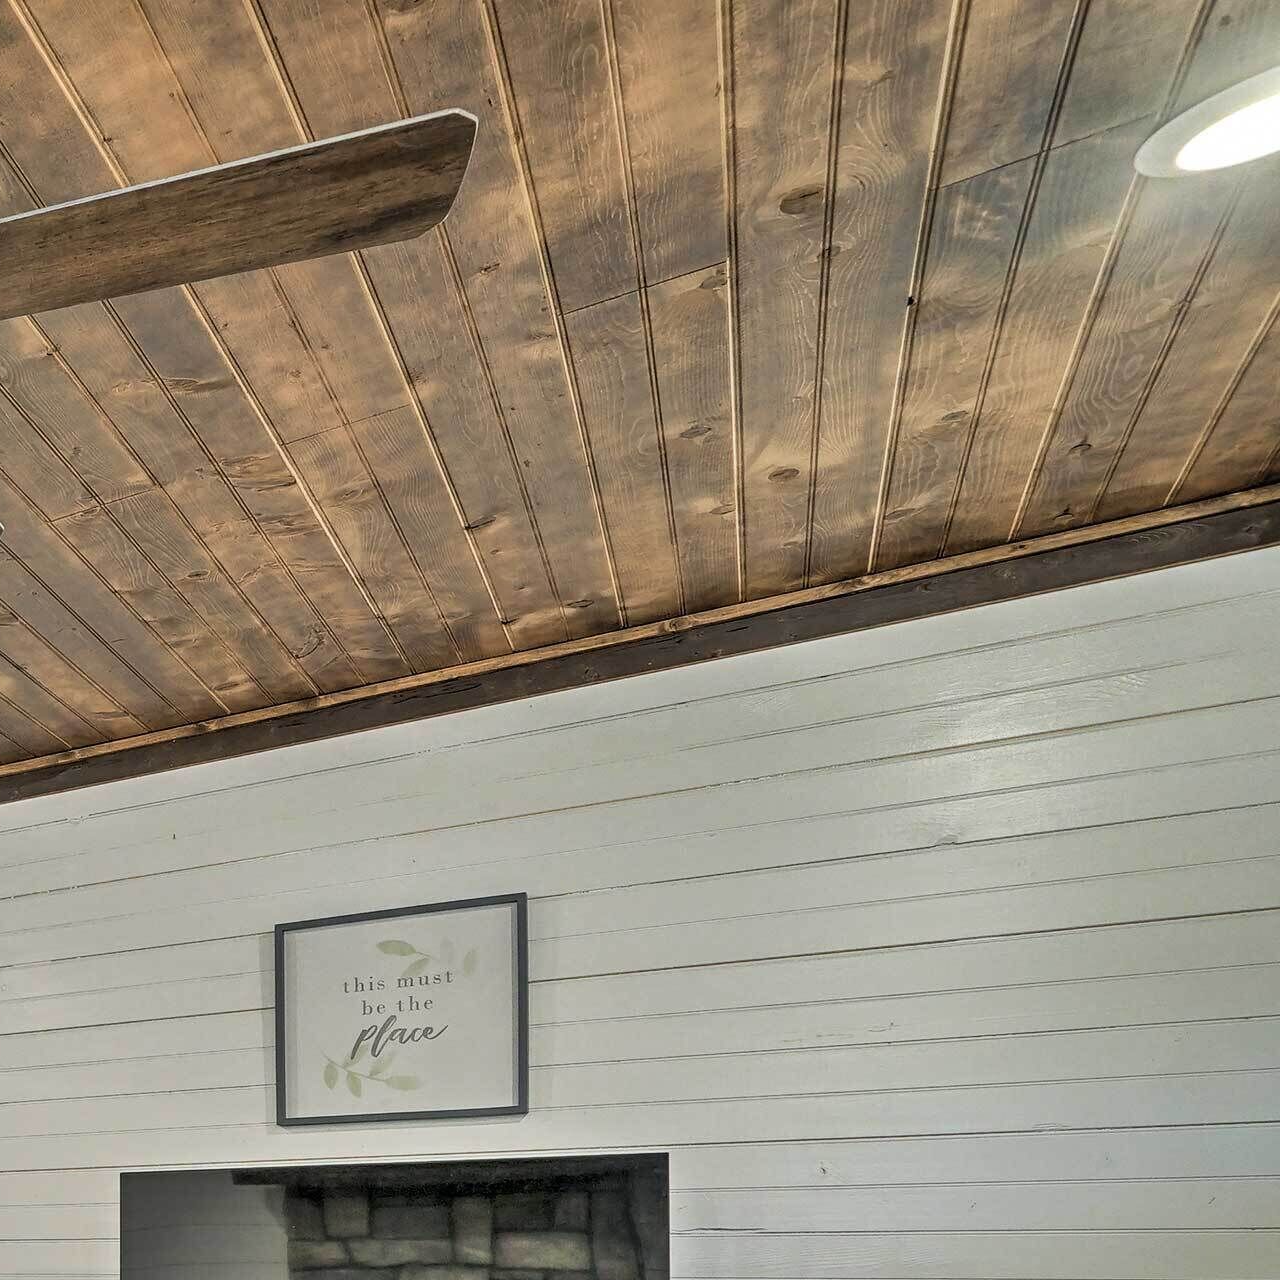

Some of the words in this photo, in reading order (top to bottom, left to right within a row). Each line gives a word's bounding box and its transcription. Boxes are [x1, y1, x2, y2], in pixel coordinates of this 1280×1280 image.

[343, 976, 386, 994] this
[397, 970, 455, 990] must
[361, 999, 386, 1016] be
[396, 995, 434, 1014] the
[350, 1014, 449, 1060] place
